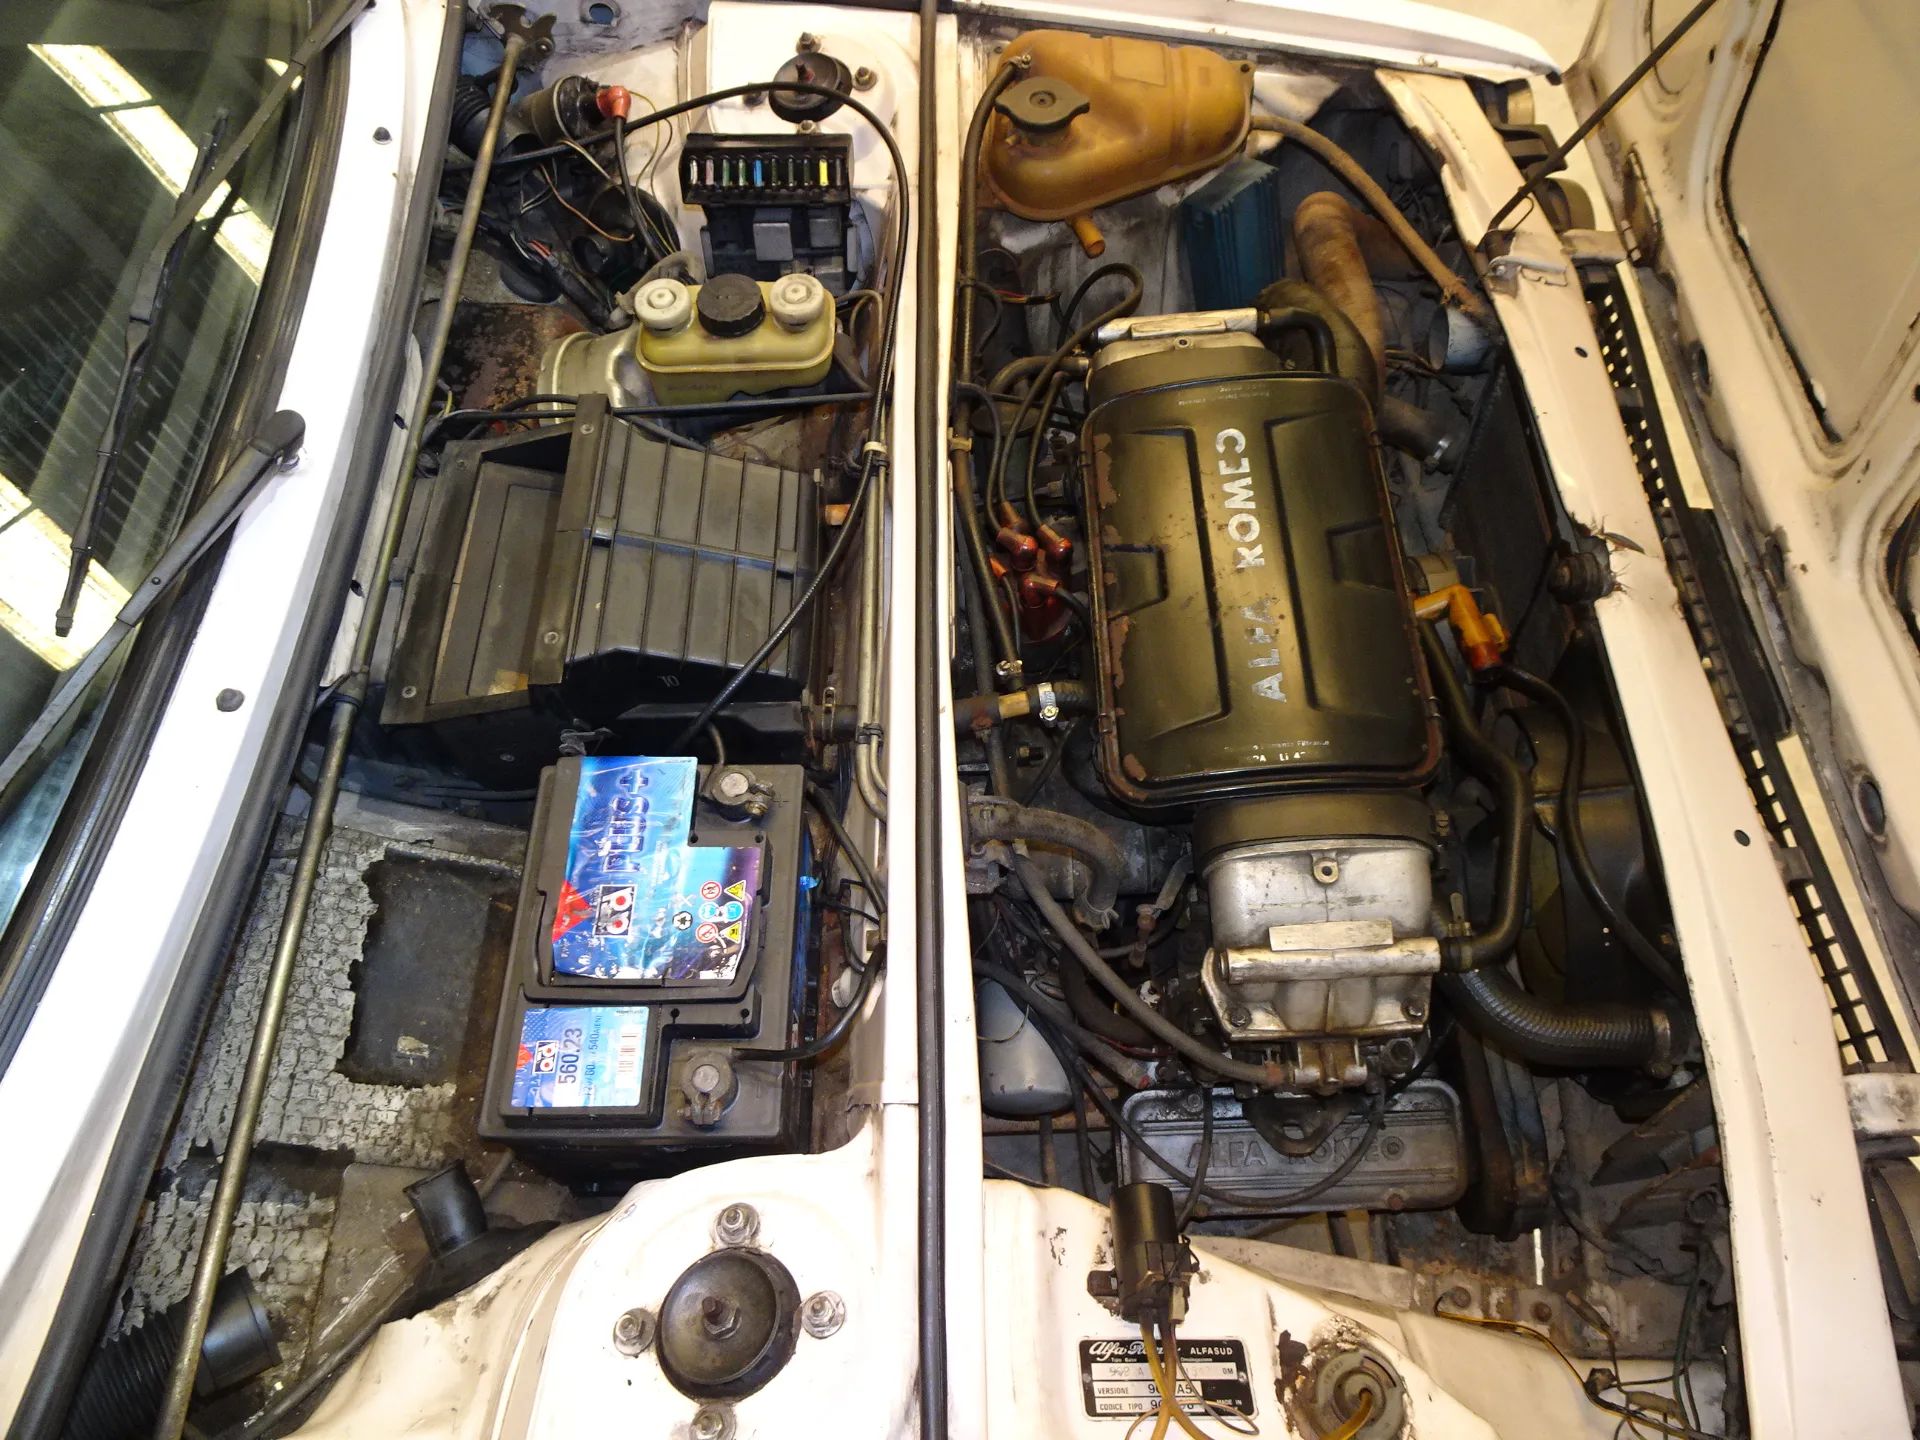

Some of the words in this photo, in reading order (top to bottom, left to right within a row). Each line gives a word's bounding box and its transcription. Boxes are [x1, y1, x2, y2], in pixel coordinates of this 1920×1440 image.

[1239, 595, 1288, 704] ALFA
[557, 1028, 583, 1084] 560.23
[1089, 1341, 1128, 1361] Alfa
[1190, 1347, 1233, 1355] ALFASUD
[1097, 1387, 1129, 1395] VERSIONE
[1099, 1403, 1123, 1411] CODICE
